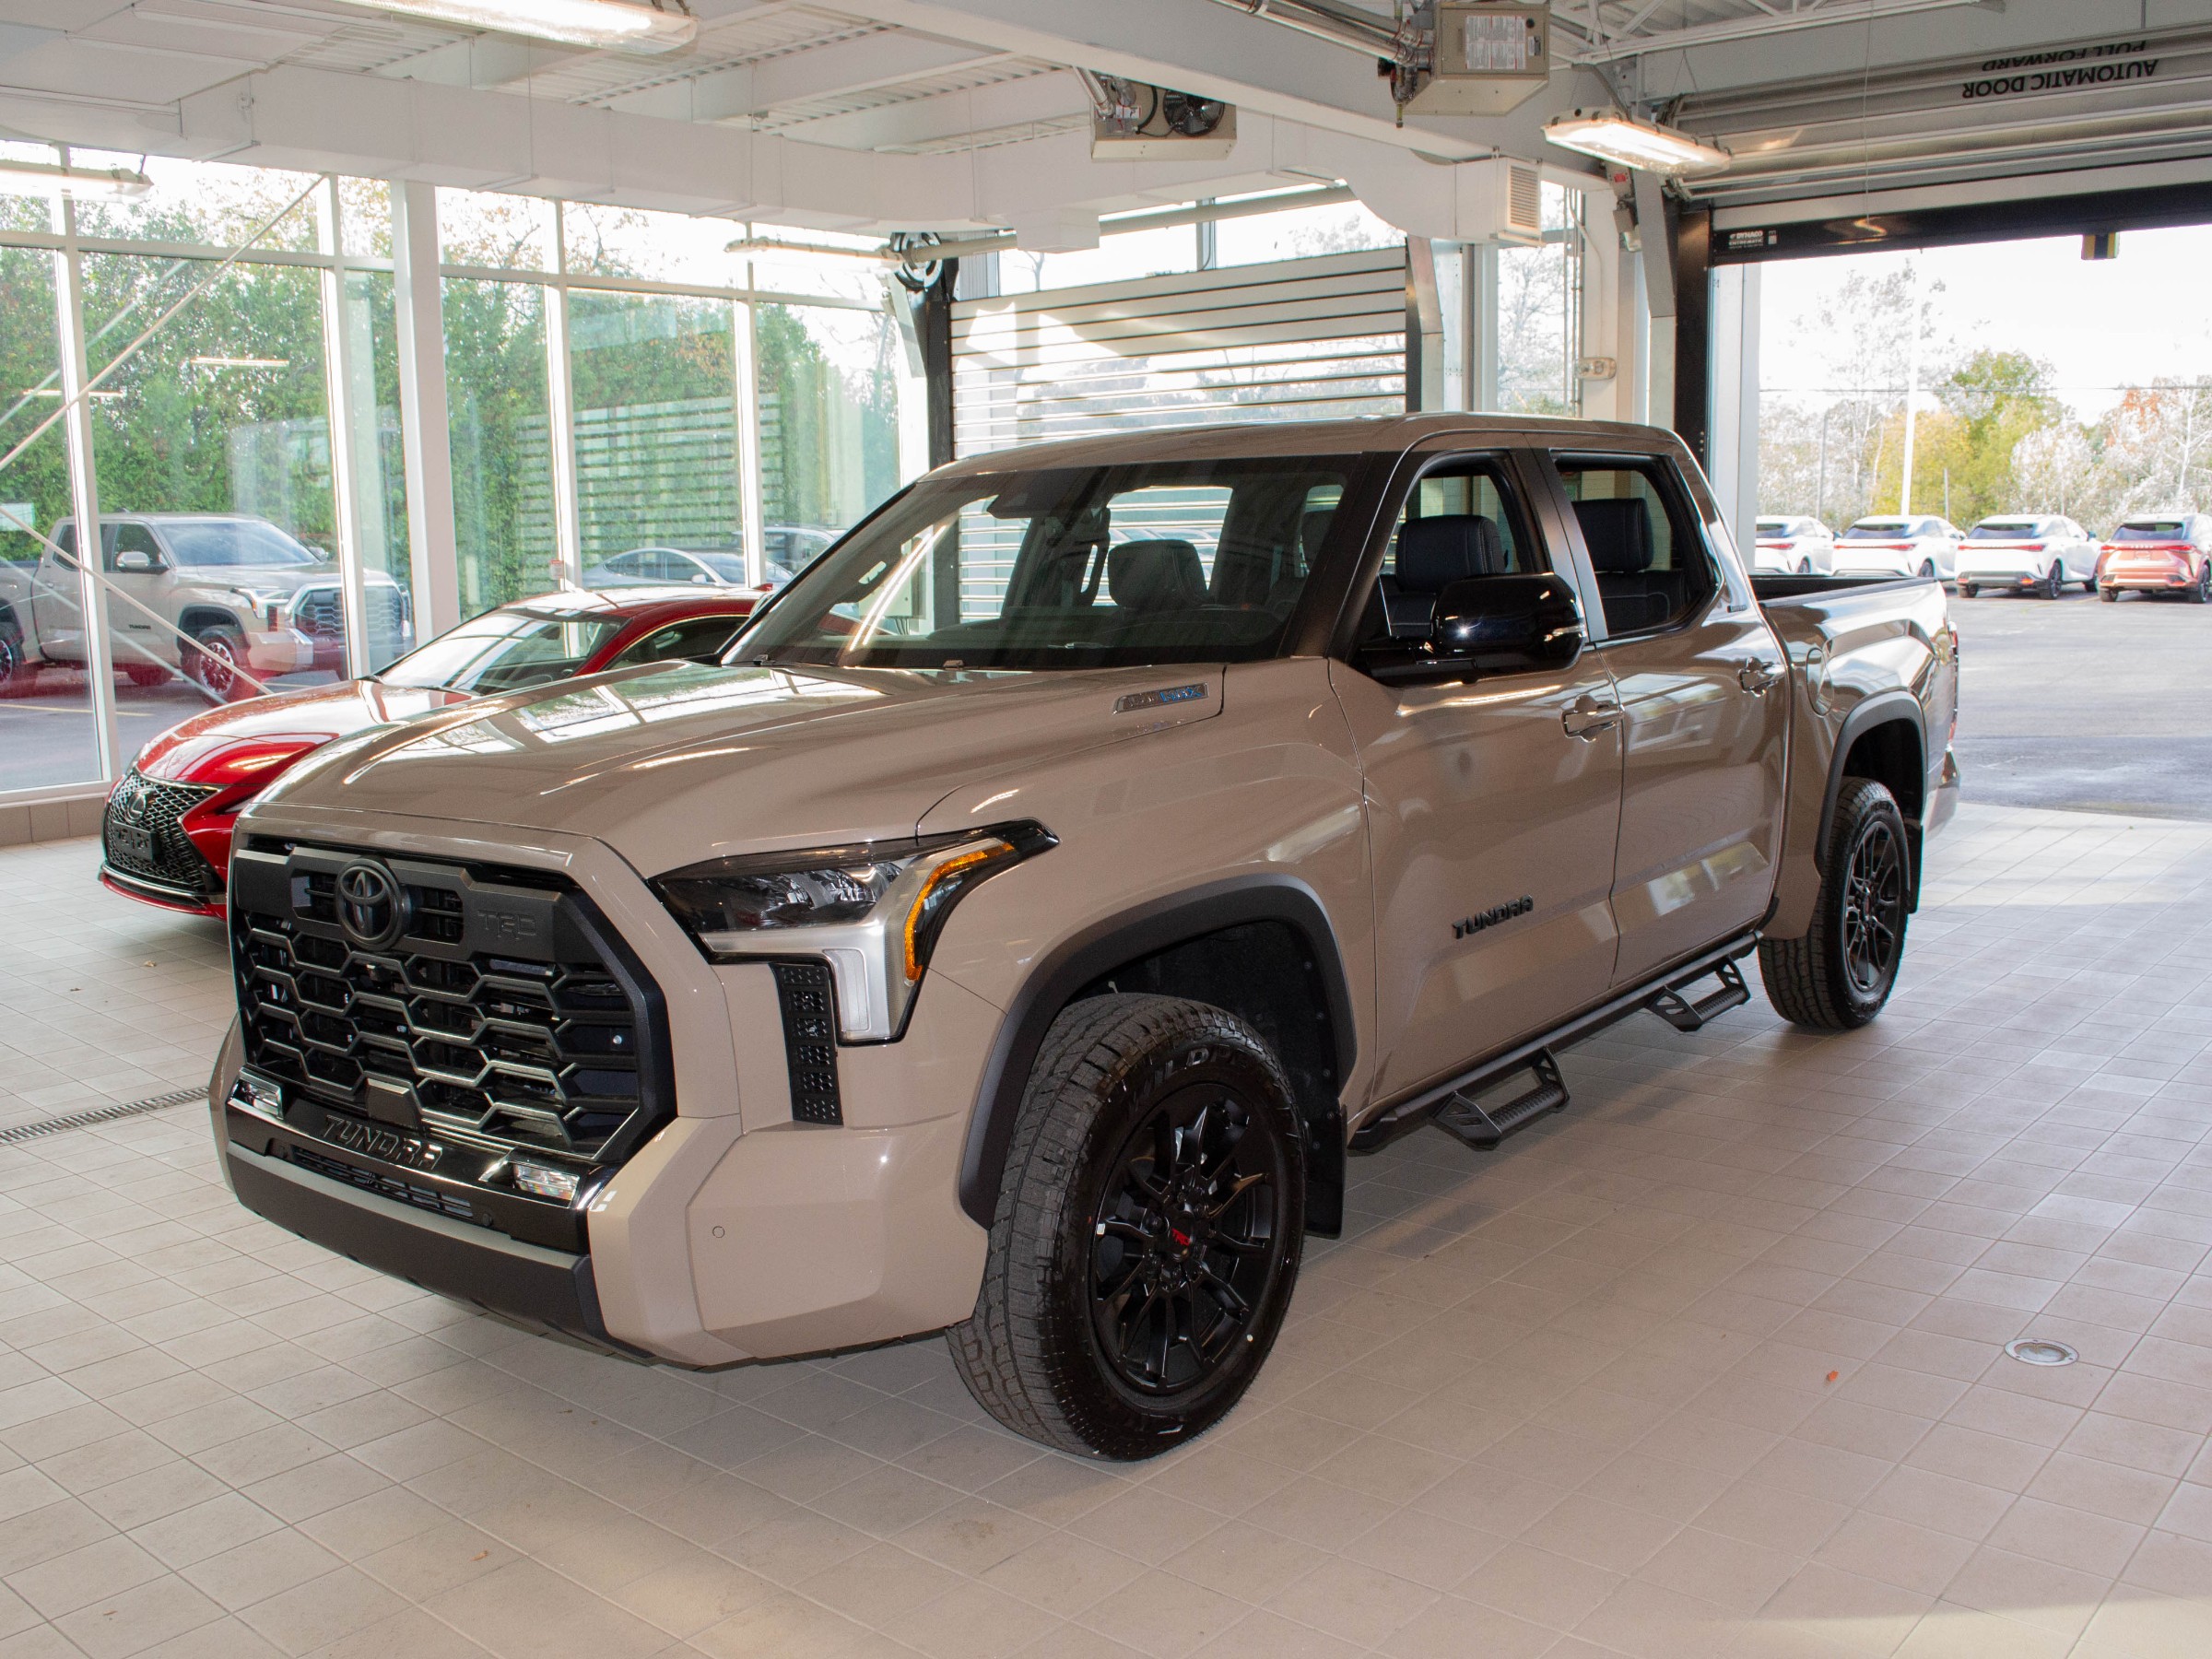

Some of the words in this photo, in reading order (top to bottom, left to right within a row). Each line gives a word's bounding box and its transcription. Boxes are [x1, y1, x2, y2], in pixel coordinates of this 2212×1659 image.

[1982, 47, 2086, 71] FORWARD
[2095, 41, 2147, 57] PULL
[1961, 76, 2025, 99] DOOR
[2030, 59, 2159, 90] AUTOMATIC
[477, 910, 536, 940] TRD
[1452, 894, 1534, 939] TUNDRA
[323, 1114, 442, 1170] TUNDRA
